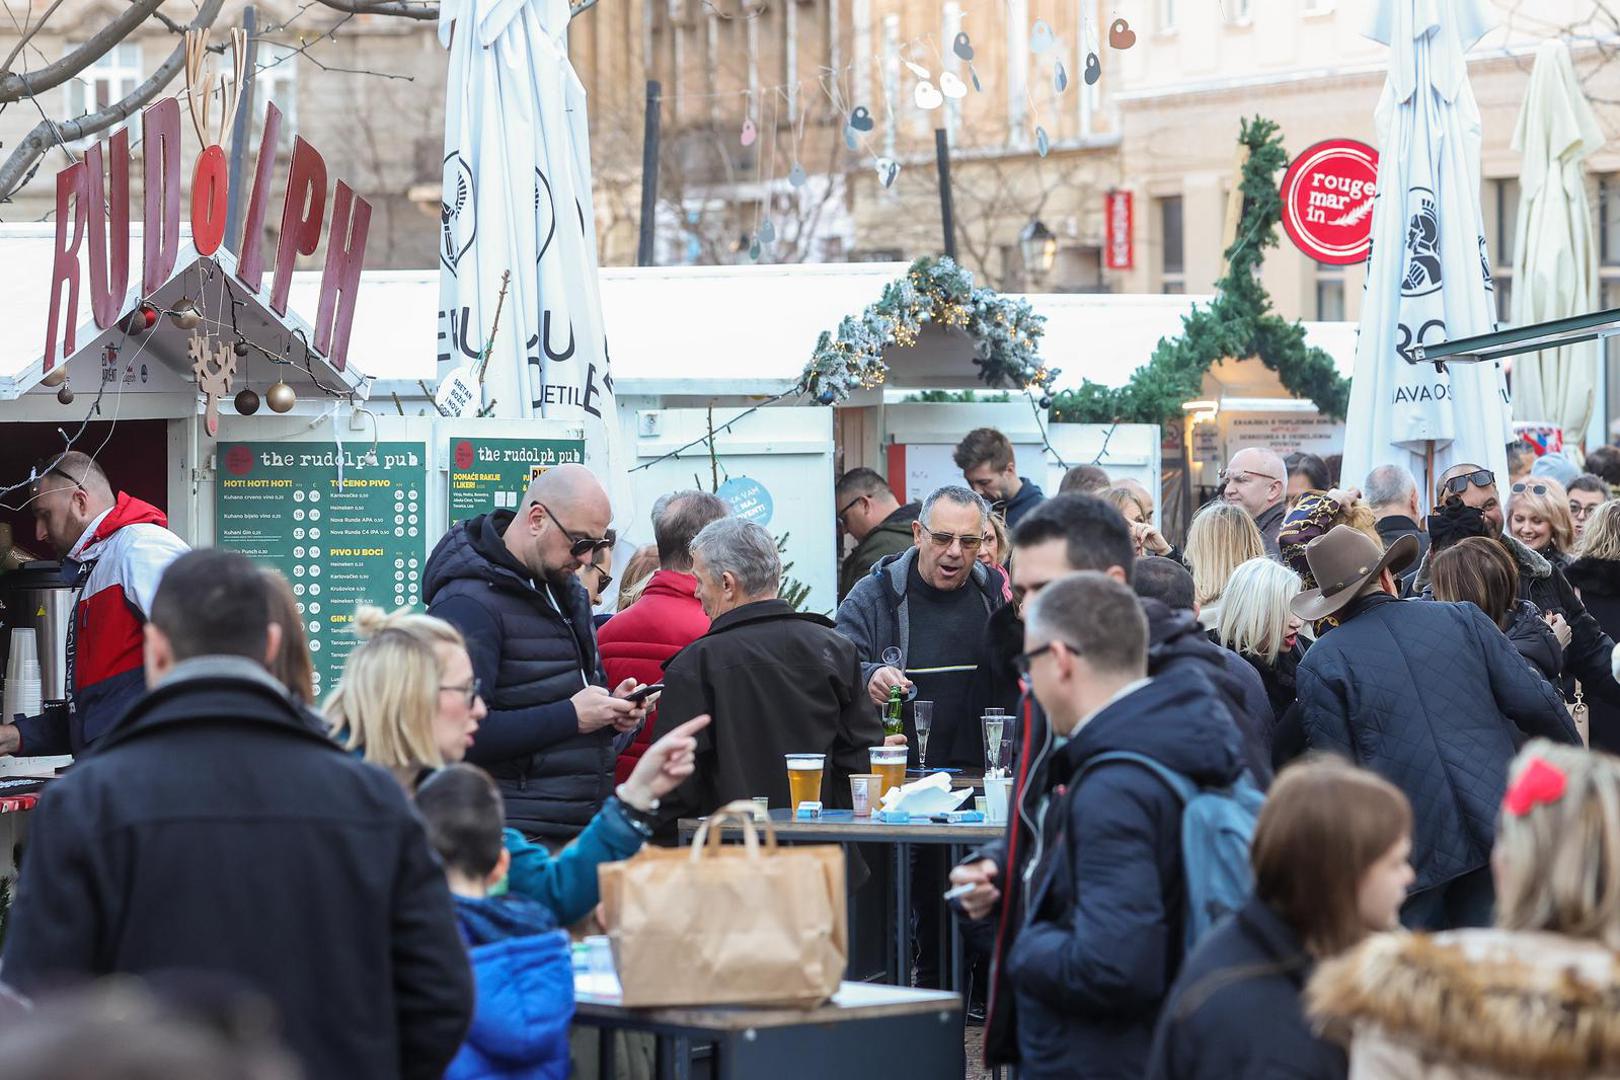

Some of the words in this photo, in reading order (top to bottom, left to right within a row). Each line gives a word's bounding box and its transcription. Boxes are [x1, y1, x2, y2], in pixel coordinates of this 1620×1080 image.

[1312, 173, 1376, 200] rouge
[1308, 190, 1350, 210] mar
[1305, 206, 1326, 224] in
[43, 97, 373, 374] RUDOLPH
[453, 378, 474, 400] SRETAN
[260, 452, 294, 467] the
[384, 452, 418, 469] pub
[478, 447, 501, 461] the
[504, 447, 556, 465] rudolph
[558, 449, 581, 464] pub
[330, 478, 367, 487] TOČENO
[453, 472, 478, 480] DOMAĆE
[330, 615, 345, 623] GIN
